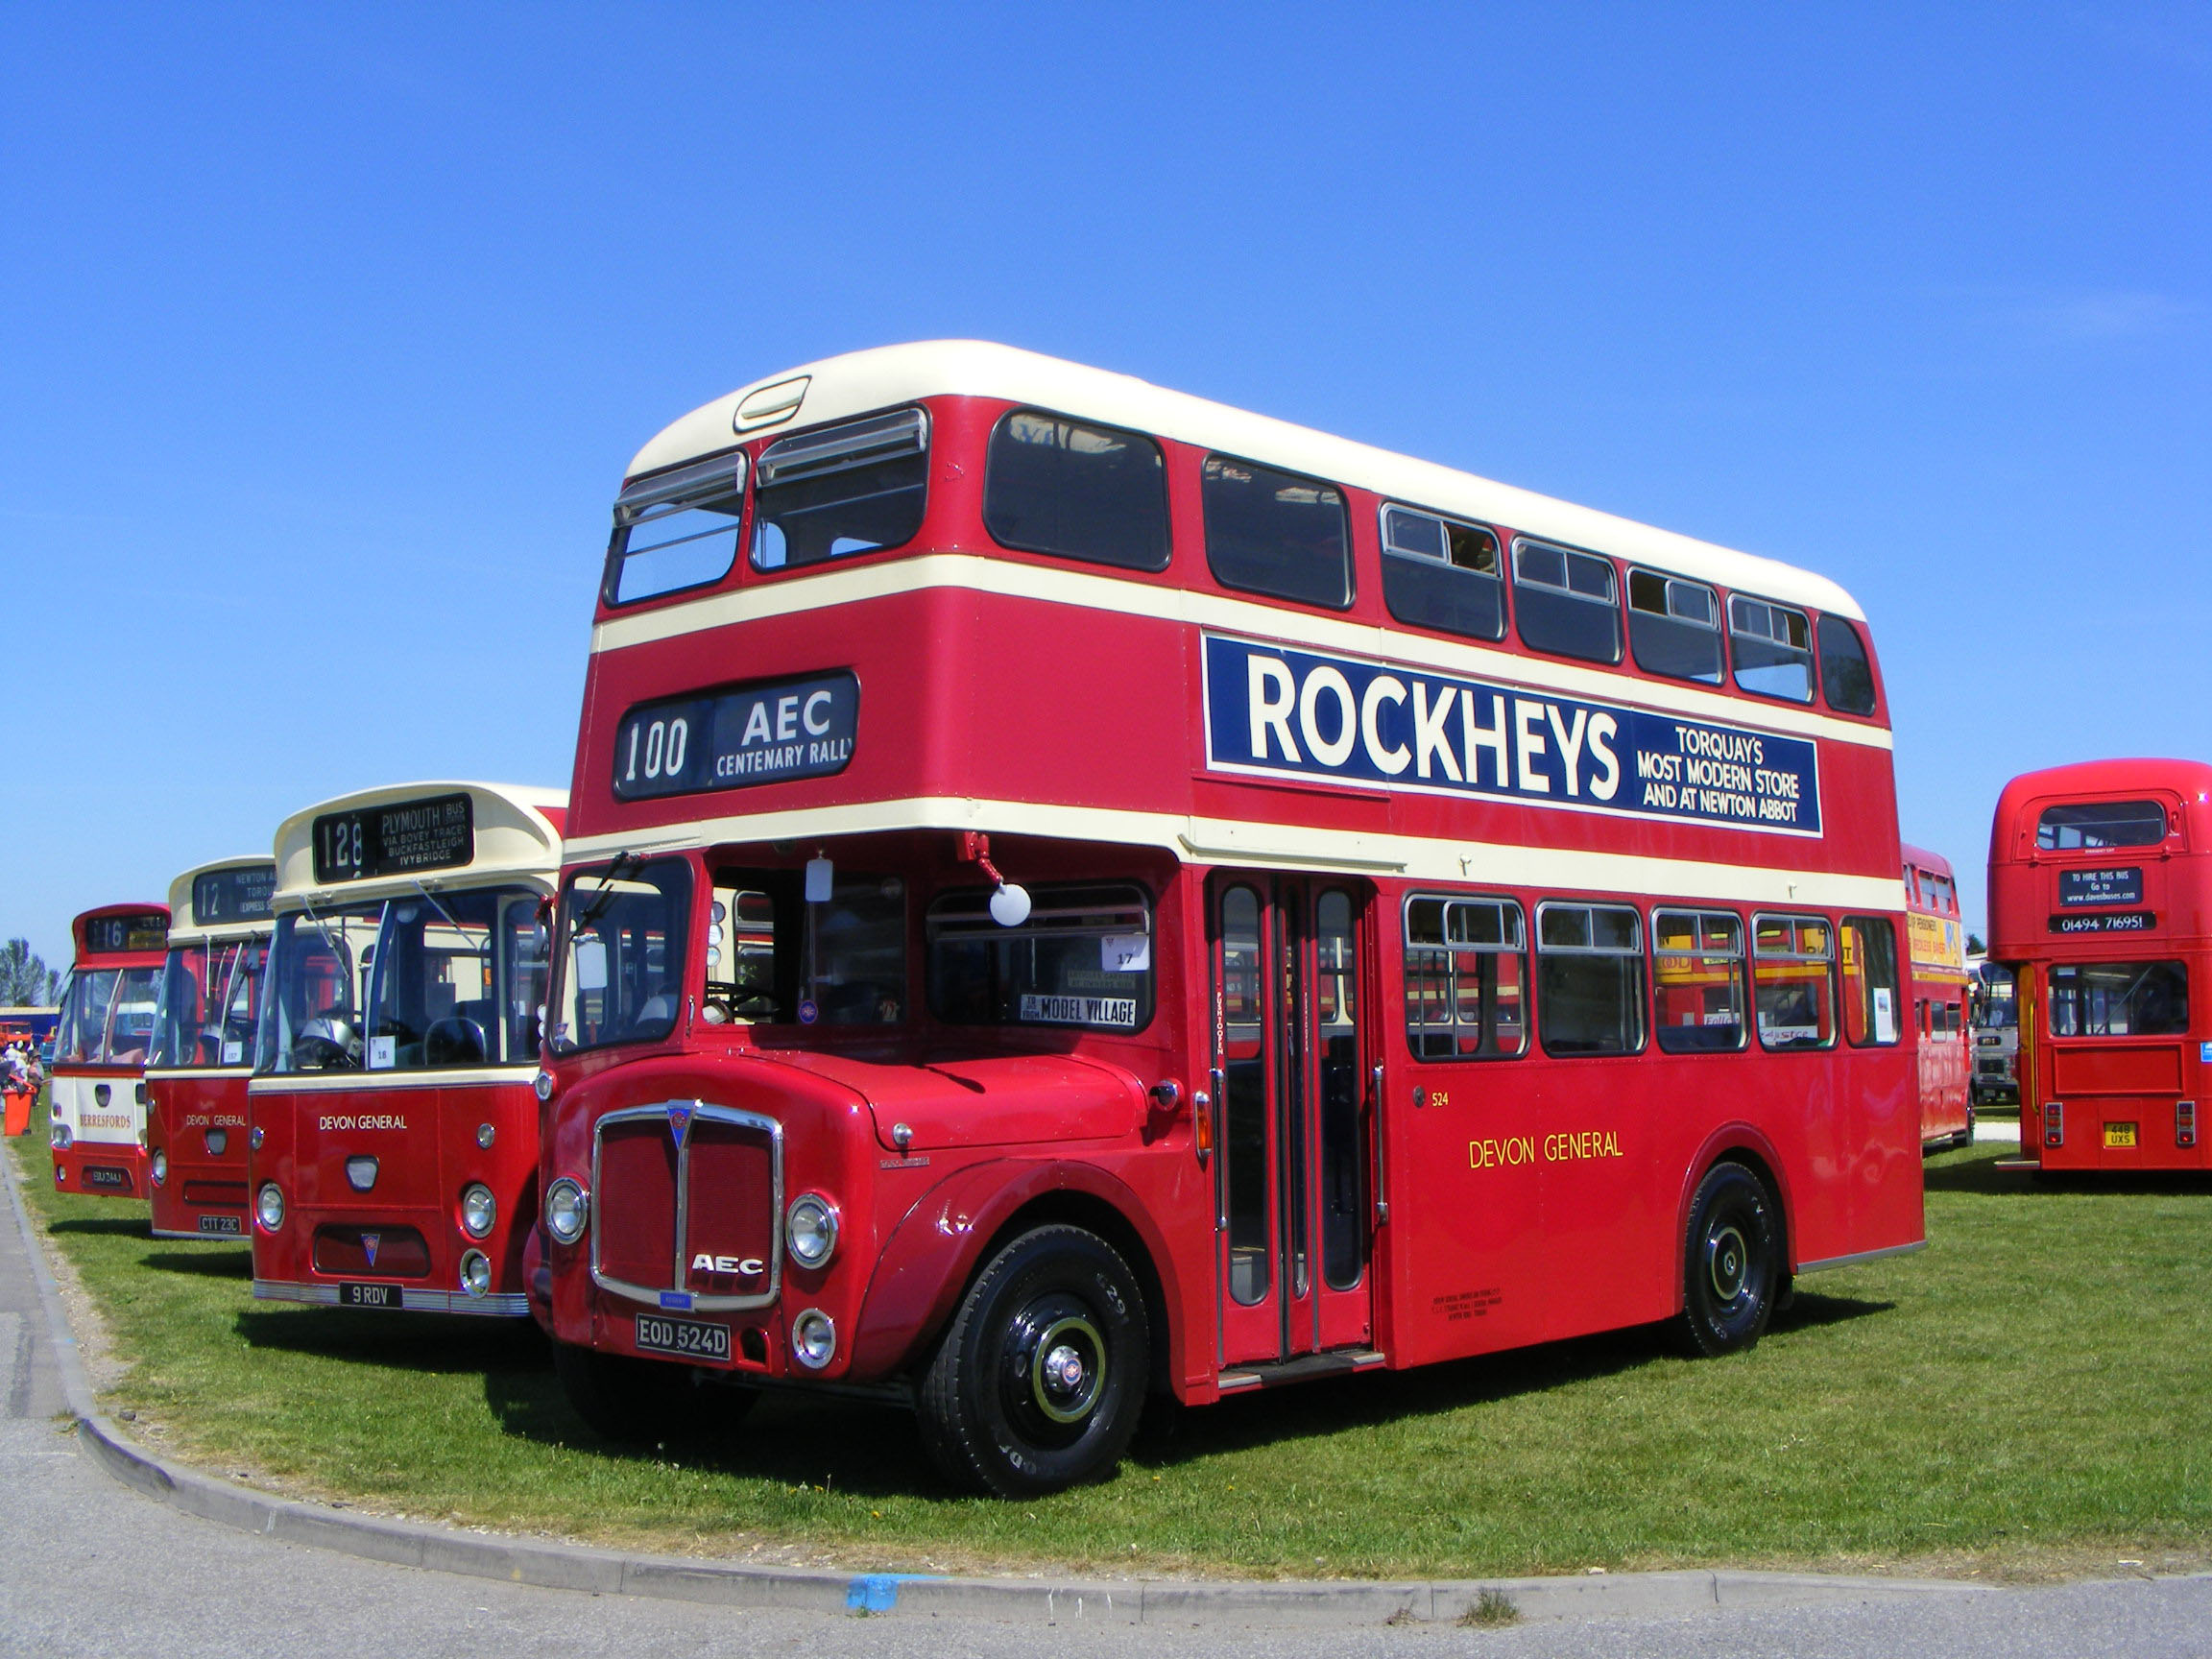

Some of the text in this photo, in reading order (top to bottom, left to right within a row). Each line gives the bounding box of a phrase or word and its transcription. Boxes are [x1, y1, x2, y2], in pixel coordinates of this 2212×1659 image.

[741, 690, 831, 747] AEC
[1246, 654, 1621, 801] ROCKHEYS
[626, 717, 688, 781] 100
[1674, 726, 1764, 765] TORQUAY'S
[716, 744, 805, 778] CENTENARY
[1637, 750, 1800, 799] MOST MODERN STORE
[1643, 782, 1797, 823] AND AT NEWTON ABBOT
[382, 806, 441, 834] PLYMOUTH
[445, 801, 466, 816] BUS
[325, 822, 363, 869] 128
[388, 836, 465, 857] BUCKFASTLEIGH
[400, 831, 430, 843] BOVEY
[399, 849, 452, 866] IVYBRIDGE
[2072, 870, 2129, 882] TO HIRE THIS BUS
[2090, 882, 2111, 891] Go to
[202, 882, 219, 918] 12
[2061, 918, 2100, 932] 01494
[1117, 952, 1134, 965] 17
[1041, 998, 1134, 1023] MODEL VILLAGE
[377, 1050, 387, 1060] 18
[1431, 1092, 1449, 1107] 524
[80, 1114, 132, 1129] BERRESFORDS
[186, 1115, 247, 1126] DEVON GENERAL
[319, 1115, 408, 1130] DEVON GENERAL
[1469, 1131, 1623, 1168] DEVON GENERAL
[2111, 1134, 2130, 1144] UXS
[202, 1217, 238, 1232] CTT 23C
[692, 1254, 764, 1275] AEC
[352, 1286, 388, 1305] 9 RDV
[639, 1319, 727, 1354] EOD 524D
